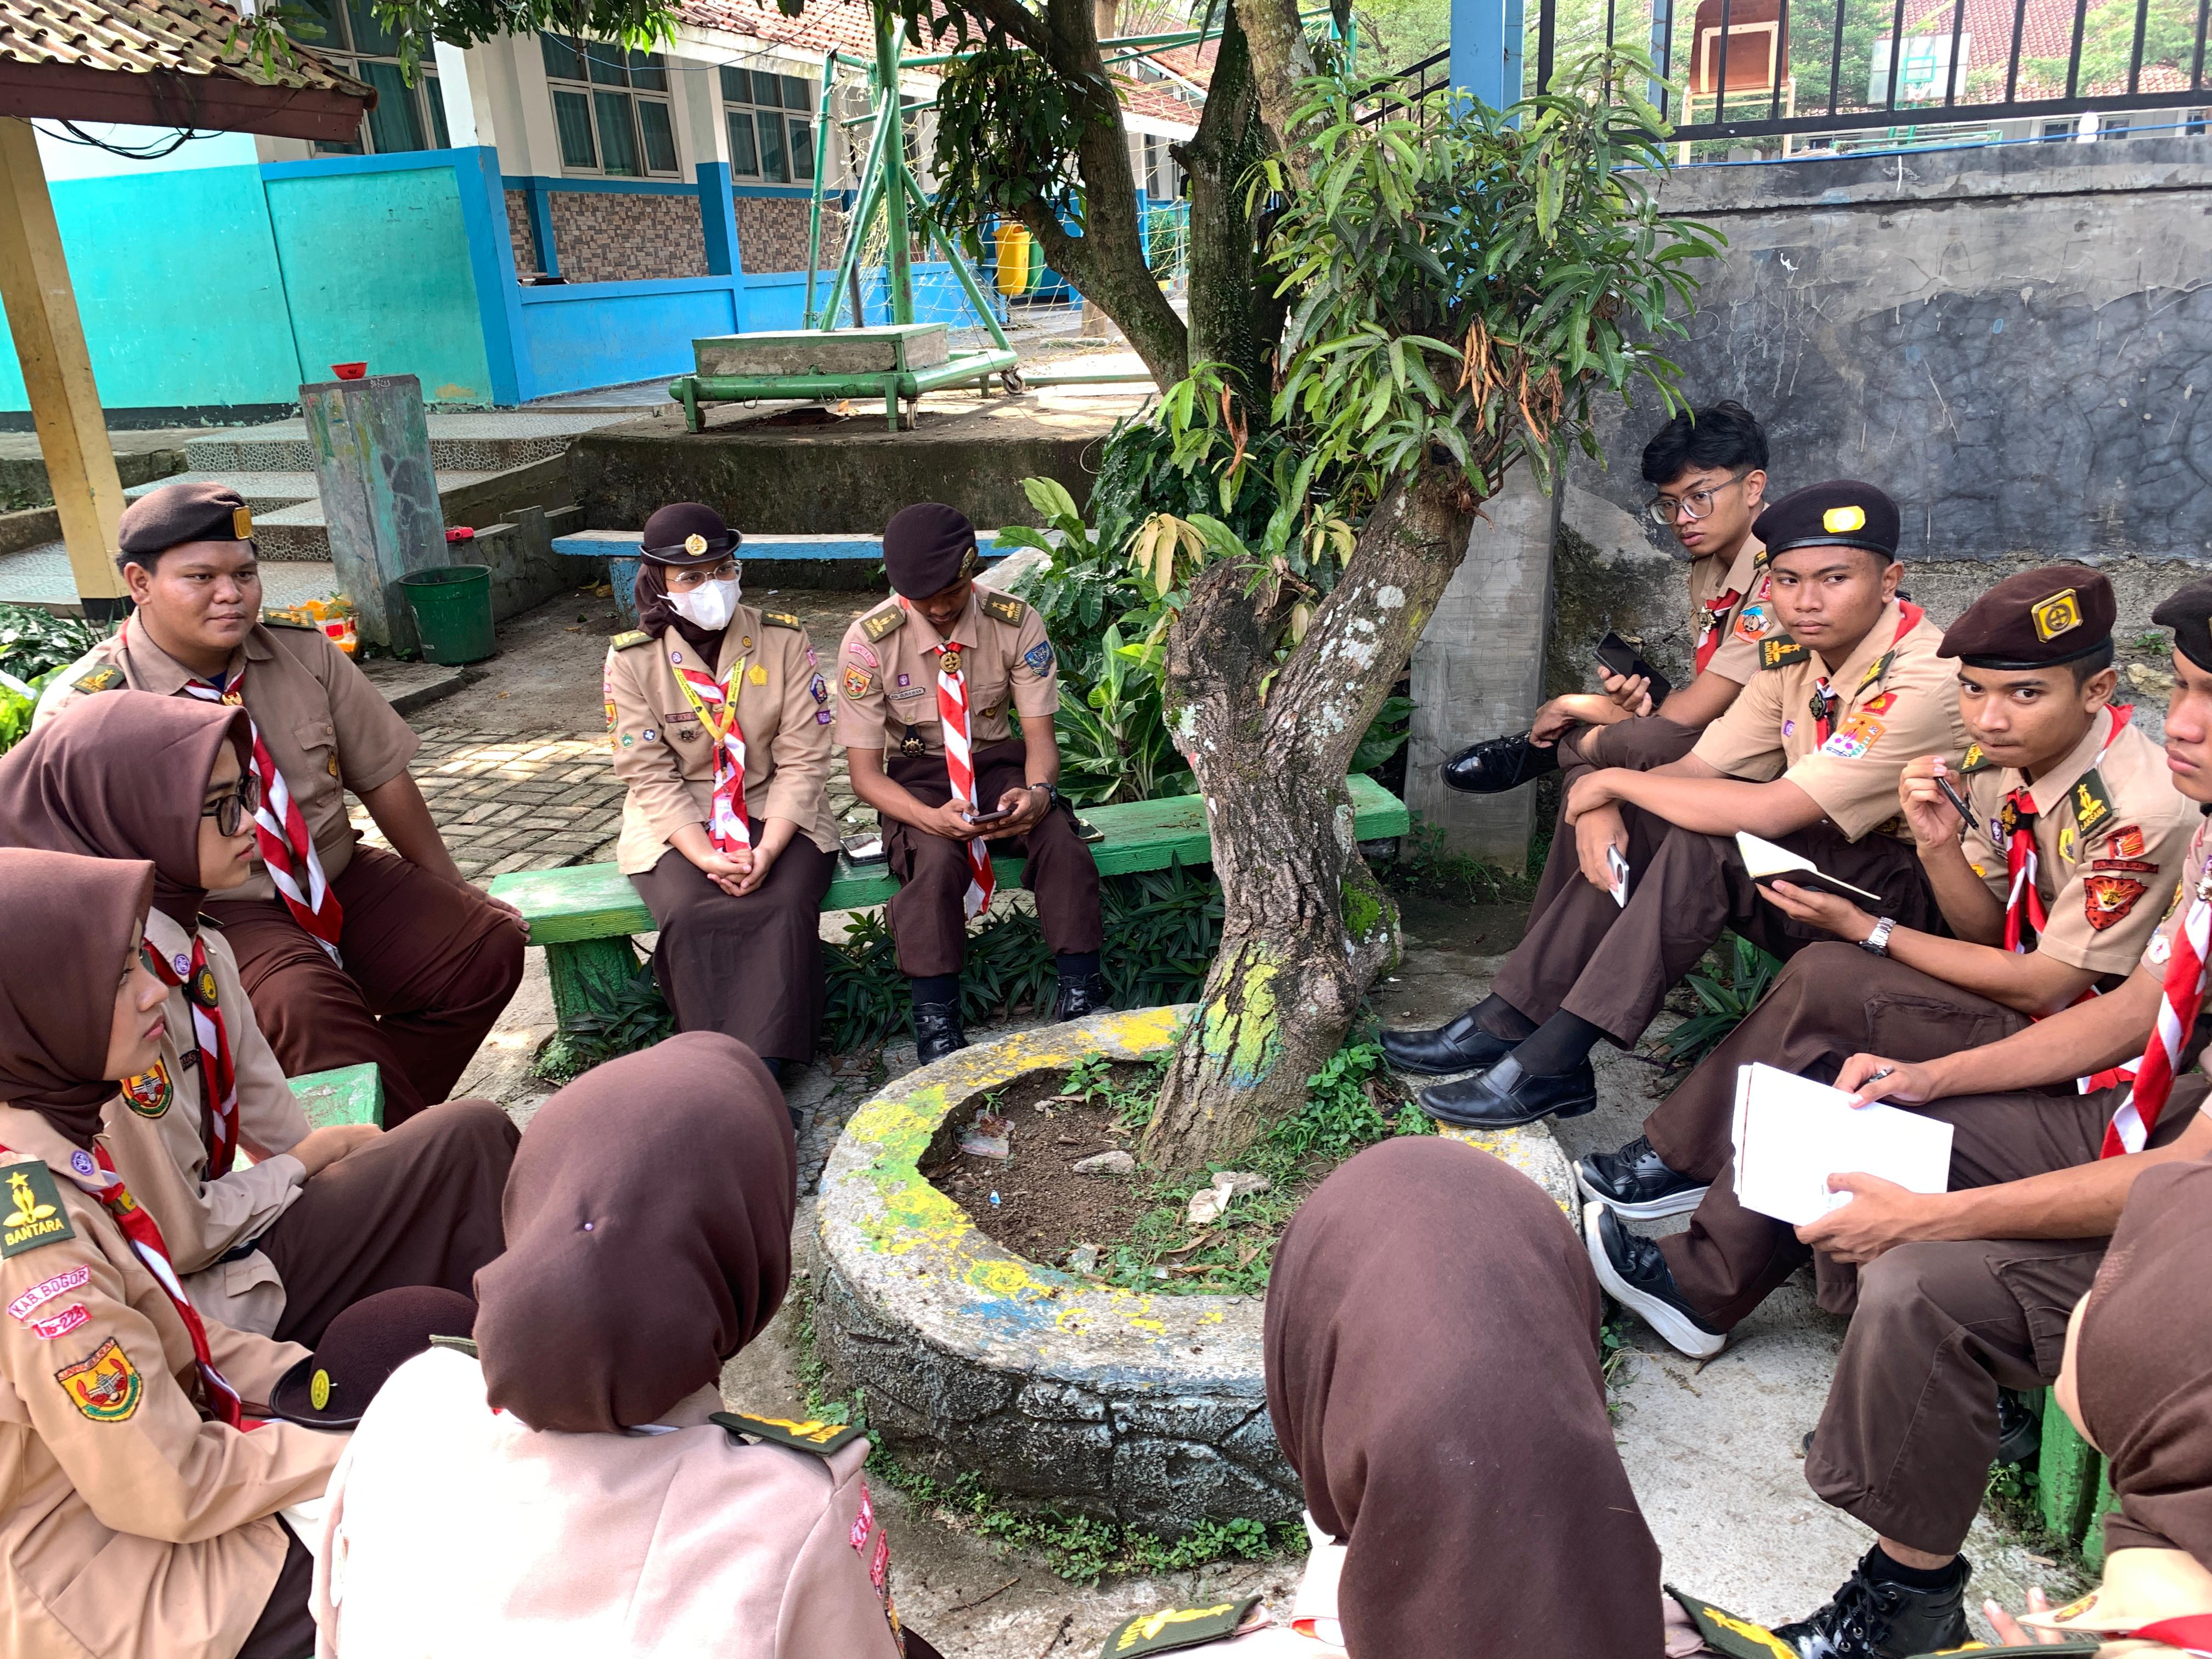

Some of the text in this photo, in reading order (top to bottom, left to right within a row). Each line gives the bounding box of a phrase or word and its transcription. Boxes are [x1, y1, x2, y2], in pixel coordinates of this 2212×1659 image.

[1764, 641, 1773, 666] BANTARA
[2080, 805, 2107, 832] LAKSANA
[4, 1218, 65, 1246] BANTARA
[41, 1270, 87, 1297] BOGOR
